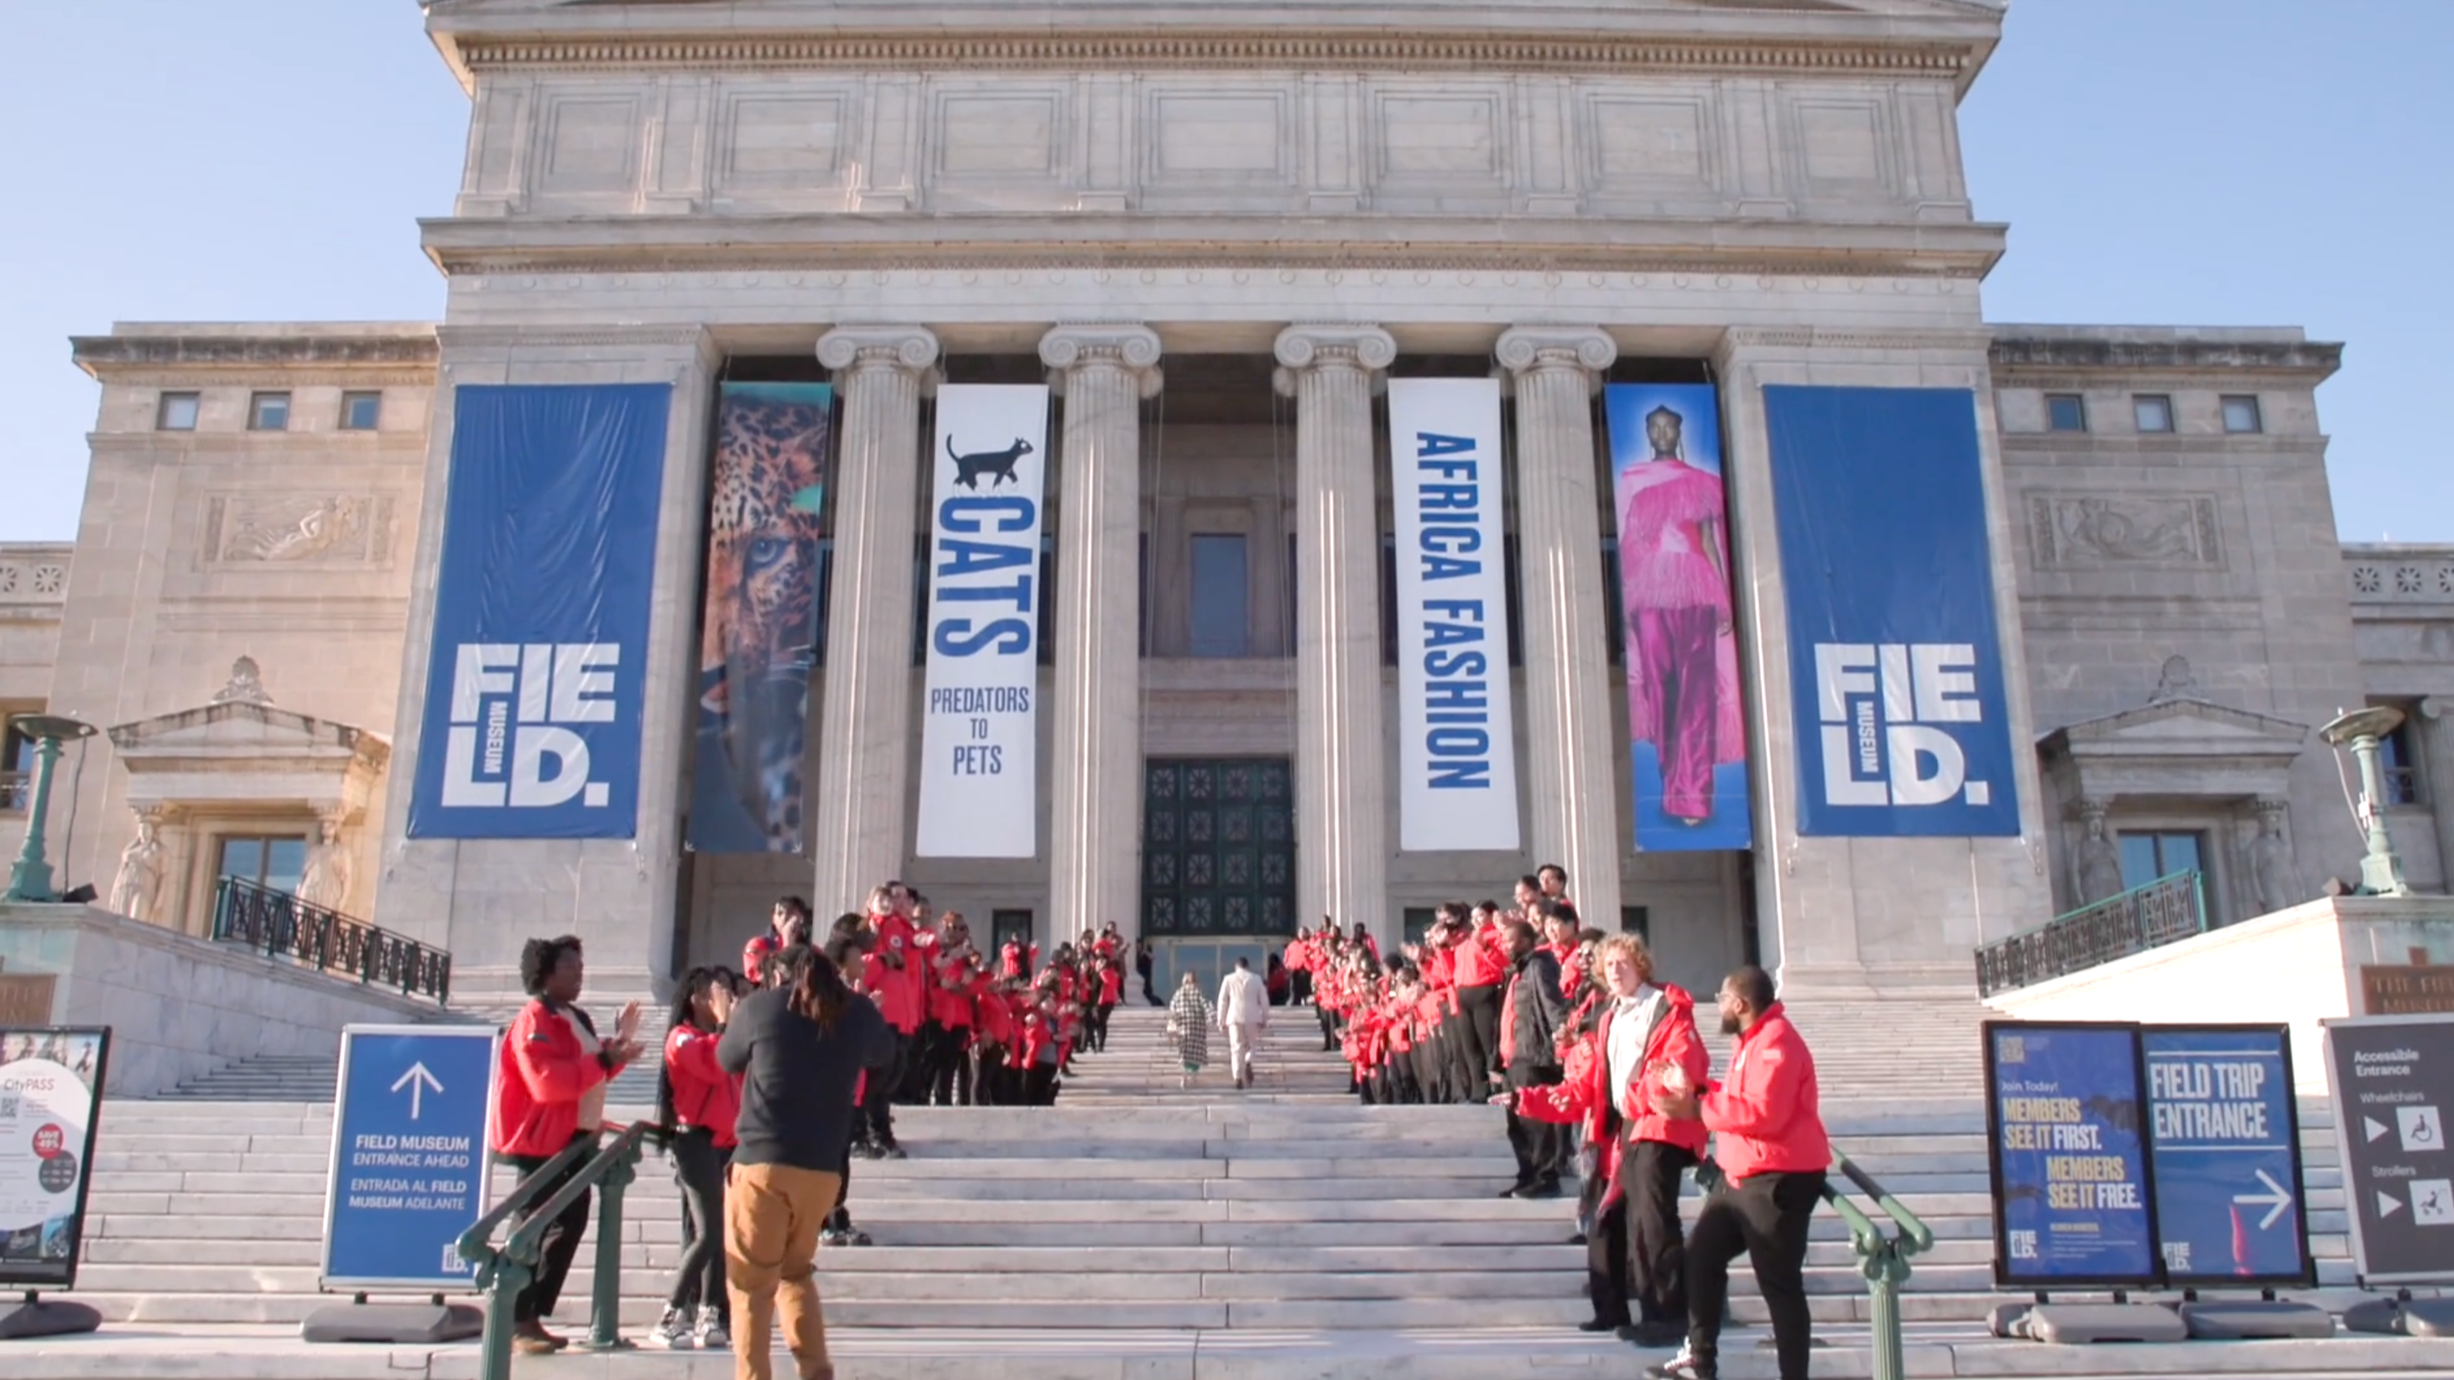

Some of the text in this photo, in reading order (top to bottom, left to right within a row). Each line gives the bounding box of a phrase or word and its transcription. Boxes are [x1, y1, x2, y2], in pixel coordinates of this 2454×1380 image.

[934, 496, 1035, 657] CATS
[1416, 431, 1490, 789] AFRICA FASHION
[931, 686, 1029, 714] PREDATORS
[484, 701, 508, 773] MUSEUM
[970, 718, 988, 739] TO
[1856, 701, 1879, 773] MUSEUM
[953, 745, 1002, 775] PETS
[2354, 1048, 2419, 1063] Accessible
[2150, 1062, 2265, 1099] FIELD TRIP
[2356, 1063, 2410, 1077] Entrance
[4, 1078, 55, 1091] CityPASS
[2002, 1081, 2023, 1091] Join
[2360, 1090, 2424, 1104] Wheelchairs
[2003, 1097, 2081, 1122] MEMBERS
[2154, 1102, 2268, 1139] ENTRANCE
[355, 1134, 470, 1151] FIELD MUSEUM
[2004, 1125, 2102, 1150] SEE IT FIRST.
[353, 1152, 469, 1168] ENTRANCE AHEAD
[2046, 1156, 2125, 1181] MEMBERS
[2371, 1165, 2417, 1178] Strollers
[351, 1178, 466, 1193] ENTRADA AL FIELD
[2048, 1183, 2142, 1209] SEE IT FREE.
[349, 1195, 465, 1210] MUSEUM ADELANTE
